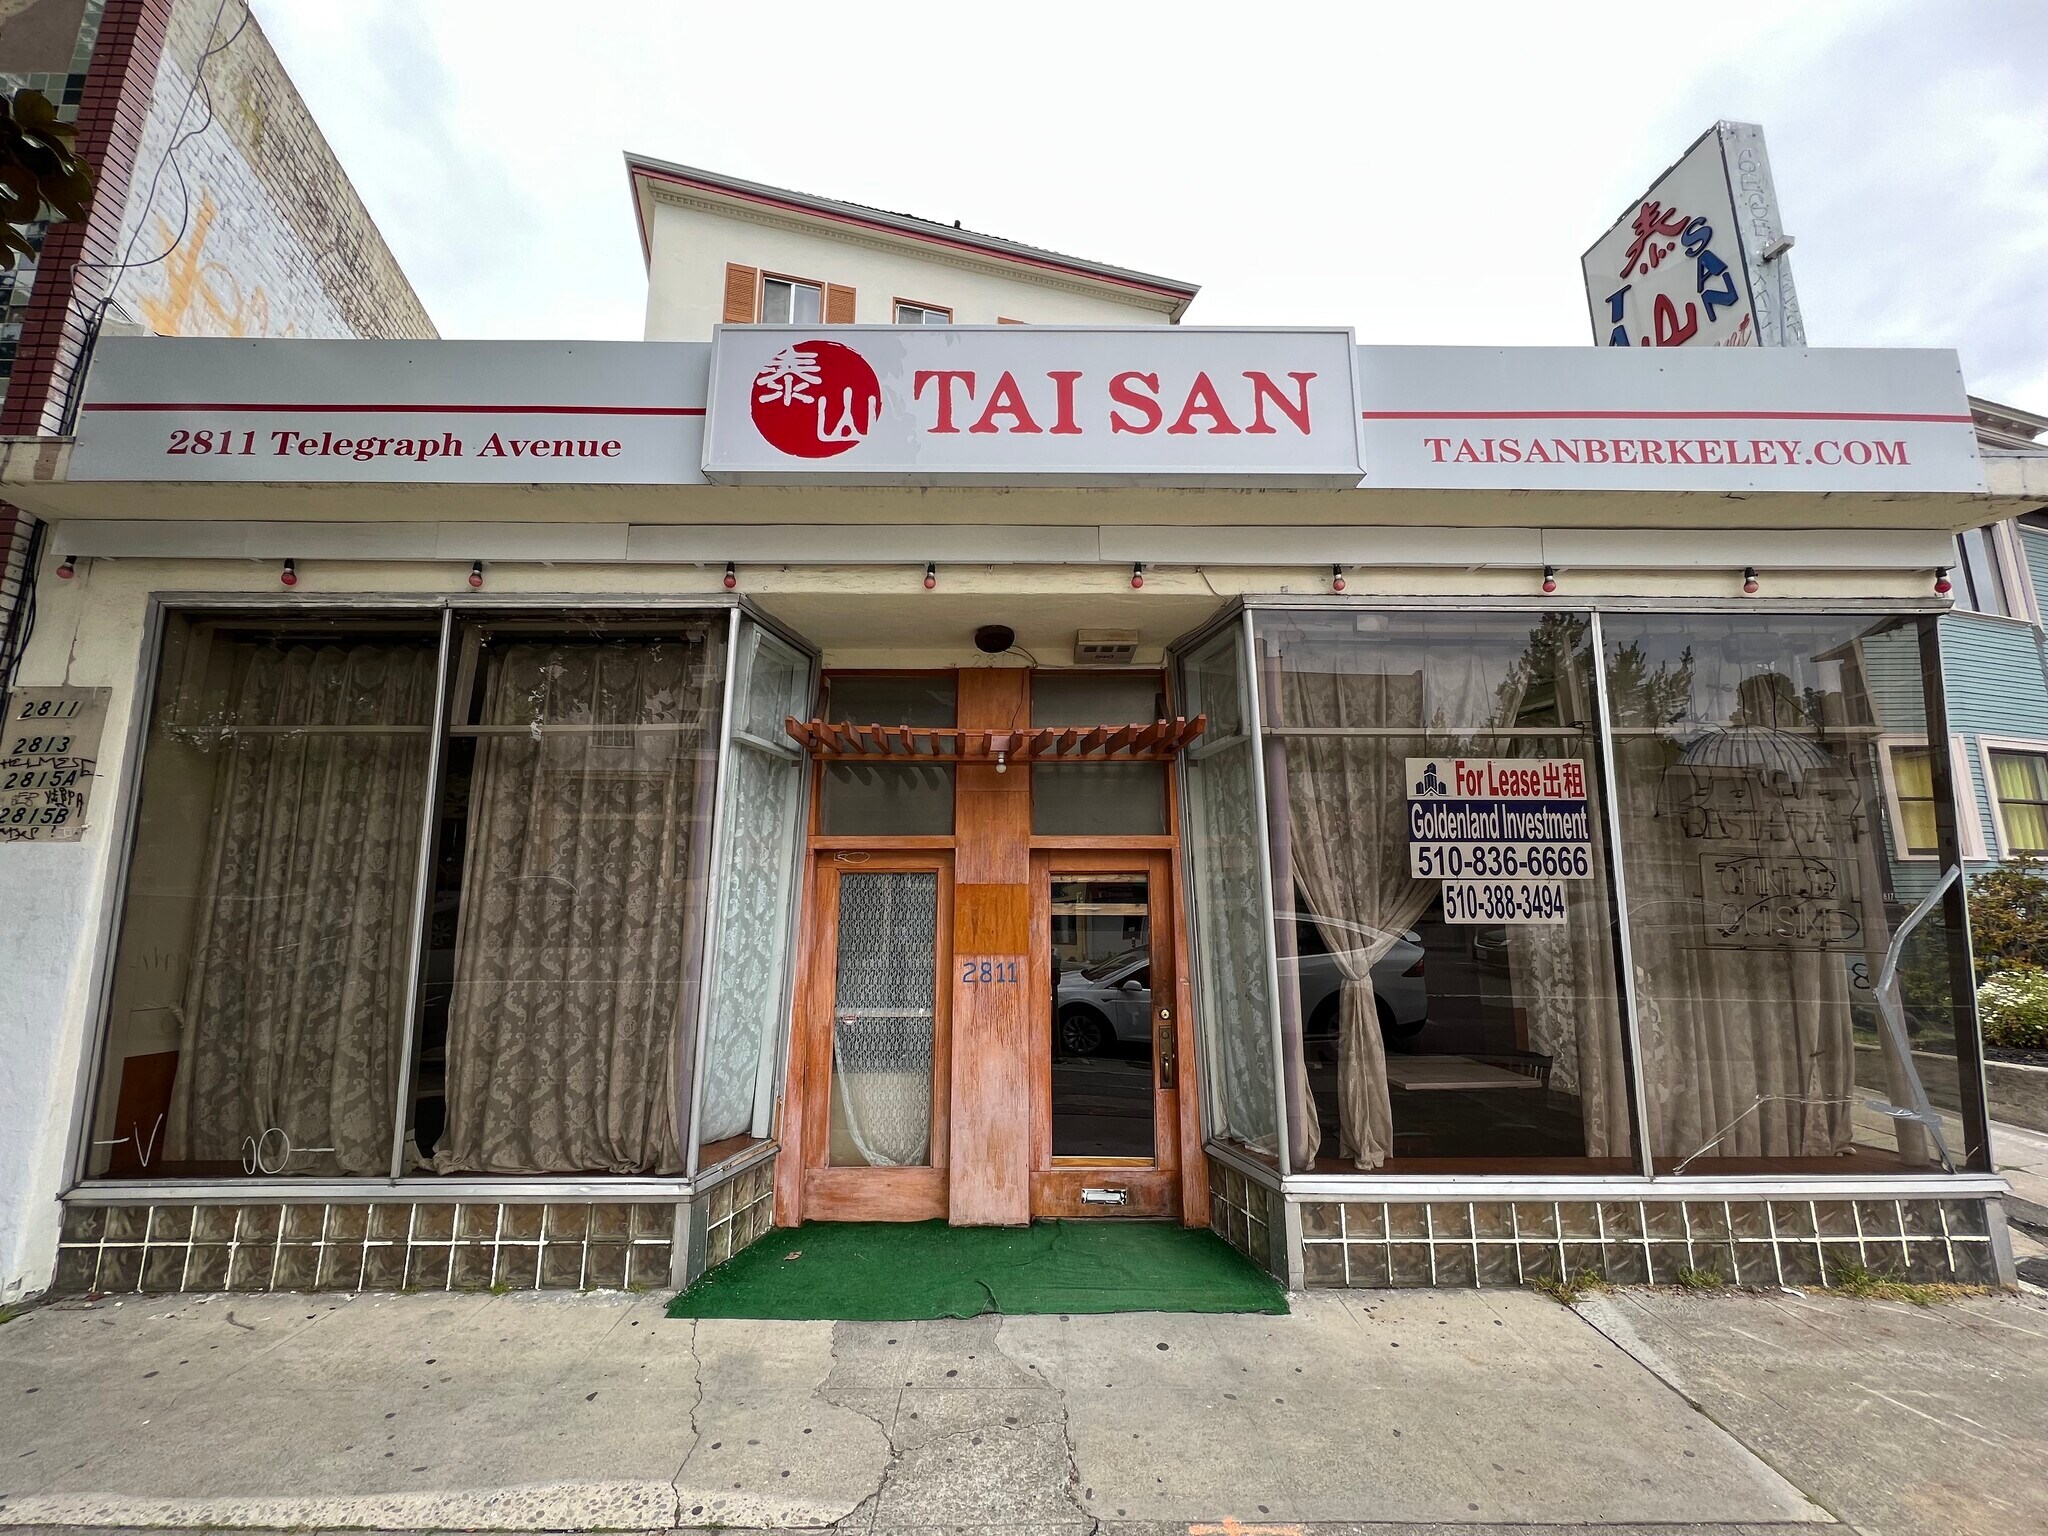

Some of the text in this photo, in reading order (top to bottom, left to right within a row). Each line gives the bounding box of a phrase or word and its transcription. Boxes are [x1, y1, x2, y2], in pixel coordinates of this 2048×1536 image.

[913, 370, 1318, 435] TAI SAN
[166, 429, 622, 462] 2811 Telegraph Avenue
[1423, 438, 1911, 466] TAISANBERKELEY.COM
[20, 700, 79, 719] 2811
[13, 736, 70, 755] 2813
[4, 770, 78, 790] 2815A
[1455, 760, 1541, 797] For Lease
[1542, 762, 1585, 798] 出租
[0, 807, 69, 825] 2815B
[1411, 802, 1589, 840] Goldenland Investment
[1418, 845, 1588, 877] 510-836-6666
[1446, 884, 1565, 920] 510-388-3494
[962, 962, 1018, 983] 2811
